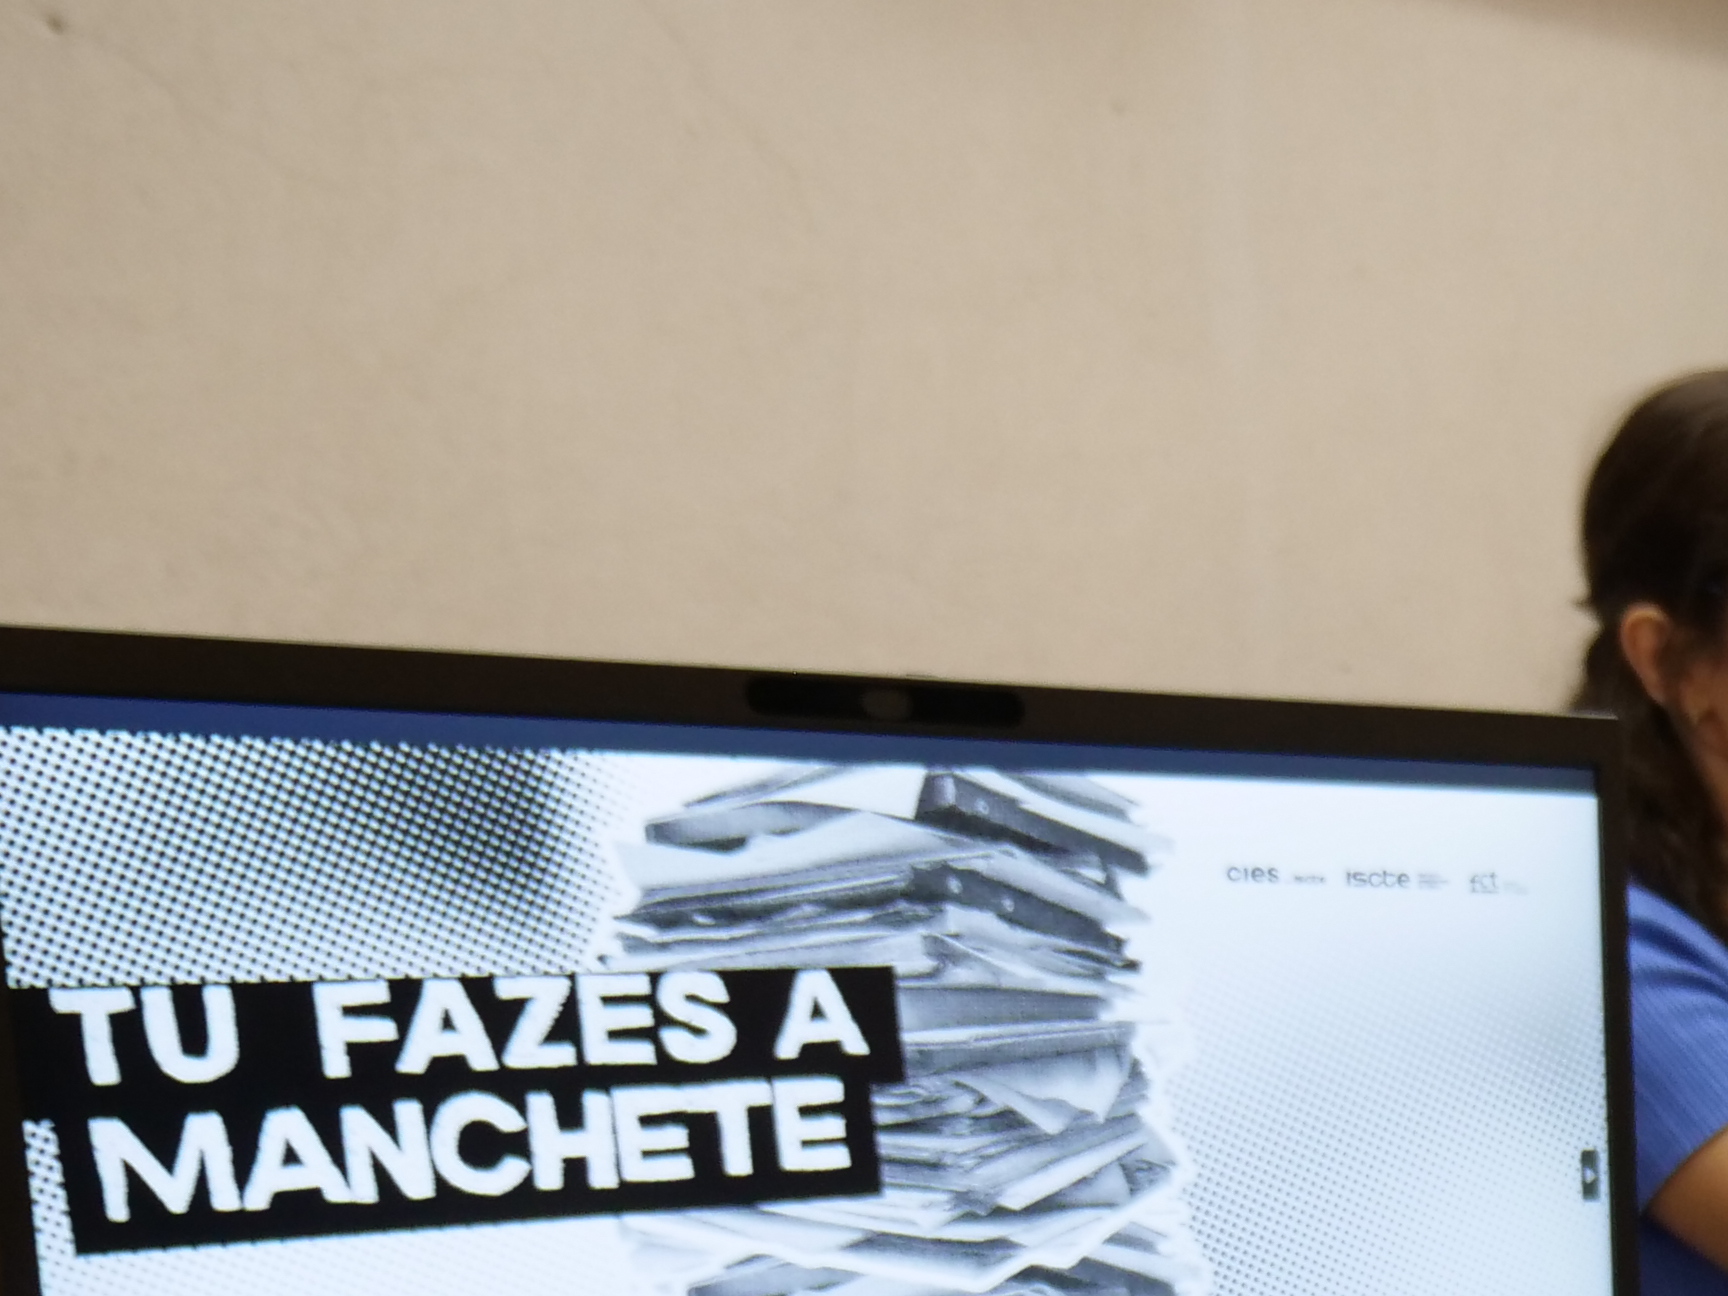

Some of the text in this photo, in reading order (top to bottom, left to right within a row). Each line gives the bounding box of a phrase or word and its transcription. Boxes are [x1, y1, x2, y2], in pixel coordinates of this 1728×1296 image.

[1226, 866, 1279, 883] cies
[1345, 869, 1410, 889] iscte
[48, 969, 870, 1087] TU FAZES A
[87, 1077, 852, 1224] MANCHETE
